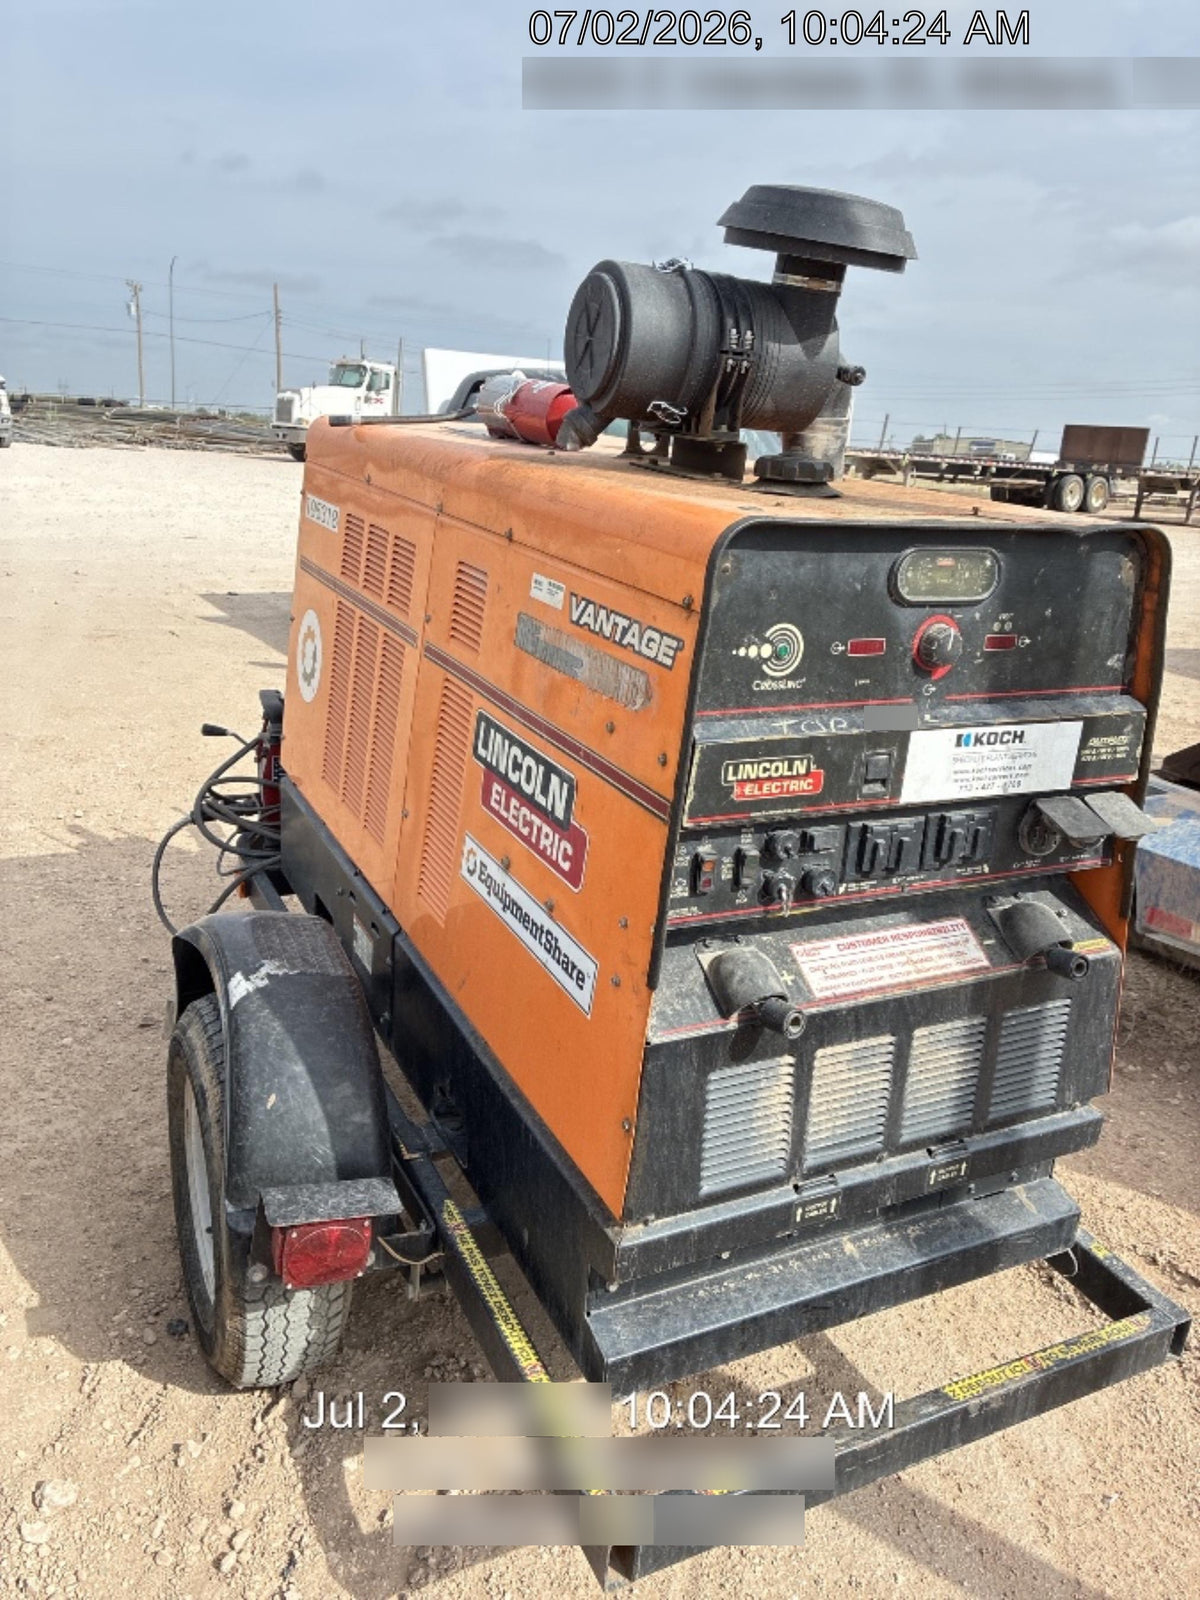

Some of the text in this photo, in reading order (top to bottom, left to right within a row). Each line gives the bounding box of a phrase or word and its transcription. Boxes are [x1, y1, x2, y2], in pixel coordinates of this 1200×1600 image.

[570, 594, 679, 667] VANTAGE
[478, 721, 568, 820] LINCOLN
[726, 759, 809, 781] LINCOLN
[972, 730, 1025, 747] KOCH
[743, 778, 813, 796] ELECTRIC
[490, 783, 573, 871] ELECTRIC
[478, 859, 586, 990] EquipmentShare
